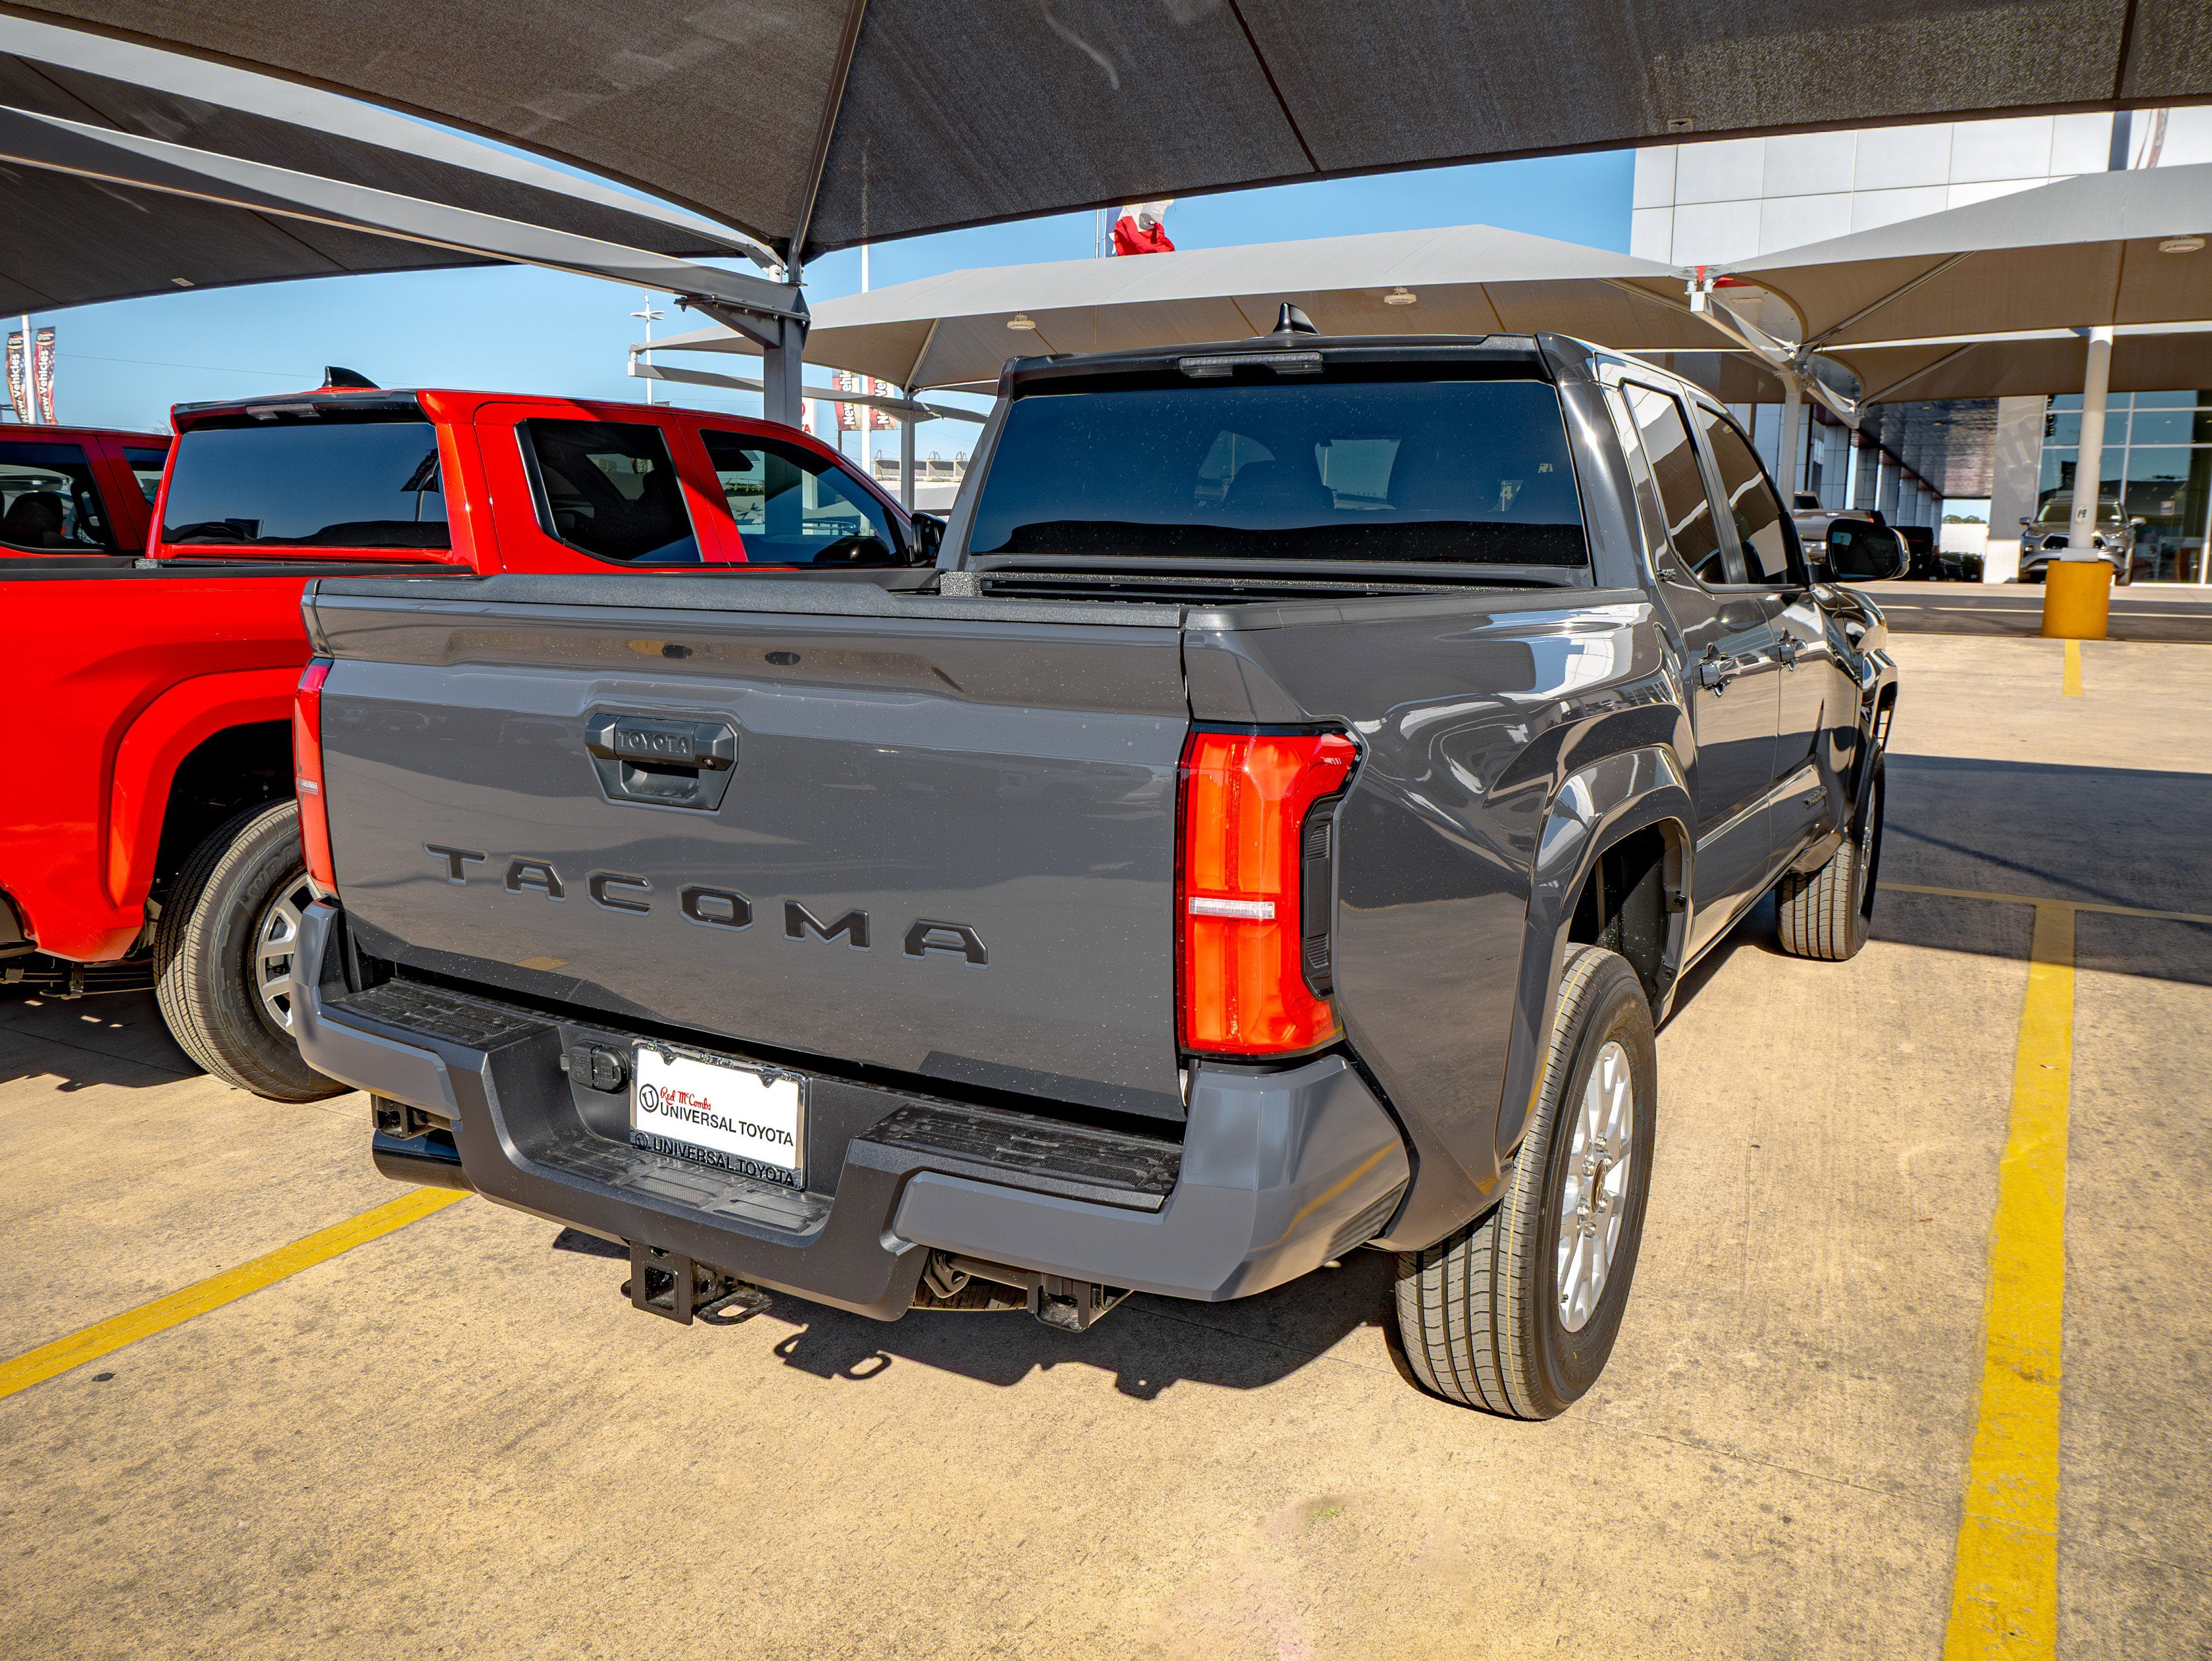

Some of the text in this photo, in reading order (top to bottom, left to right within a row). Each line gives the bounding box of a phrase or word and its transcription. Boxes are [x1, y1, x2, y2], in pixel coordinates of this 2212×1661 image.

[10, 353, 21, 398] Vehicles
[38, 349, 49, 395] Vehicles
[41, 396, 52, 420] New
[618, 731, 688, 754] TOYOTA
[423, 842, 989, 970] TACOMA
[660, 1087, 711, 1110] Red McCombs
[661, 1102, 794, 1147] UNIVERSAL TOYOTA
[653, 1136, 796, 1187] UNIVERSAL TOYOTA
